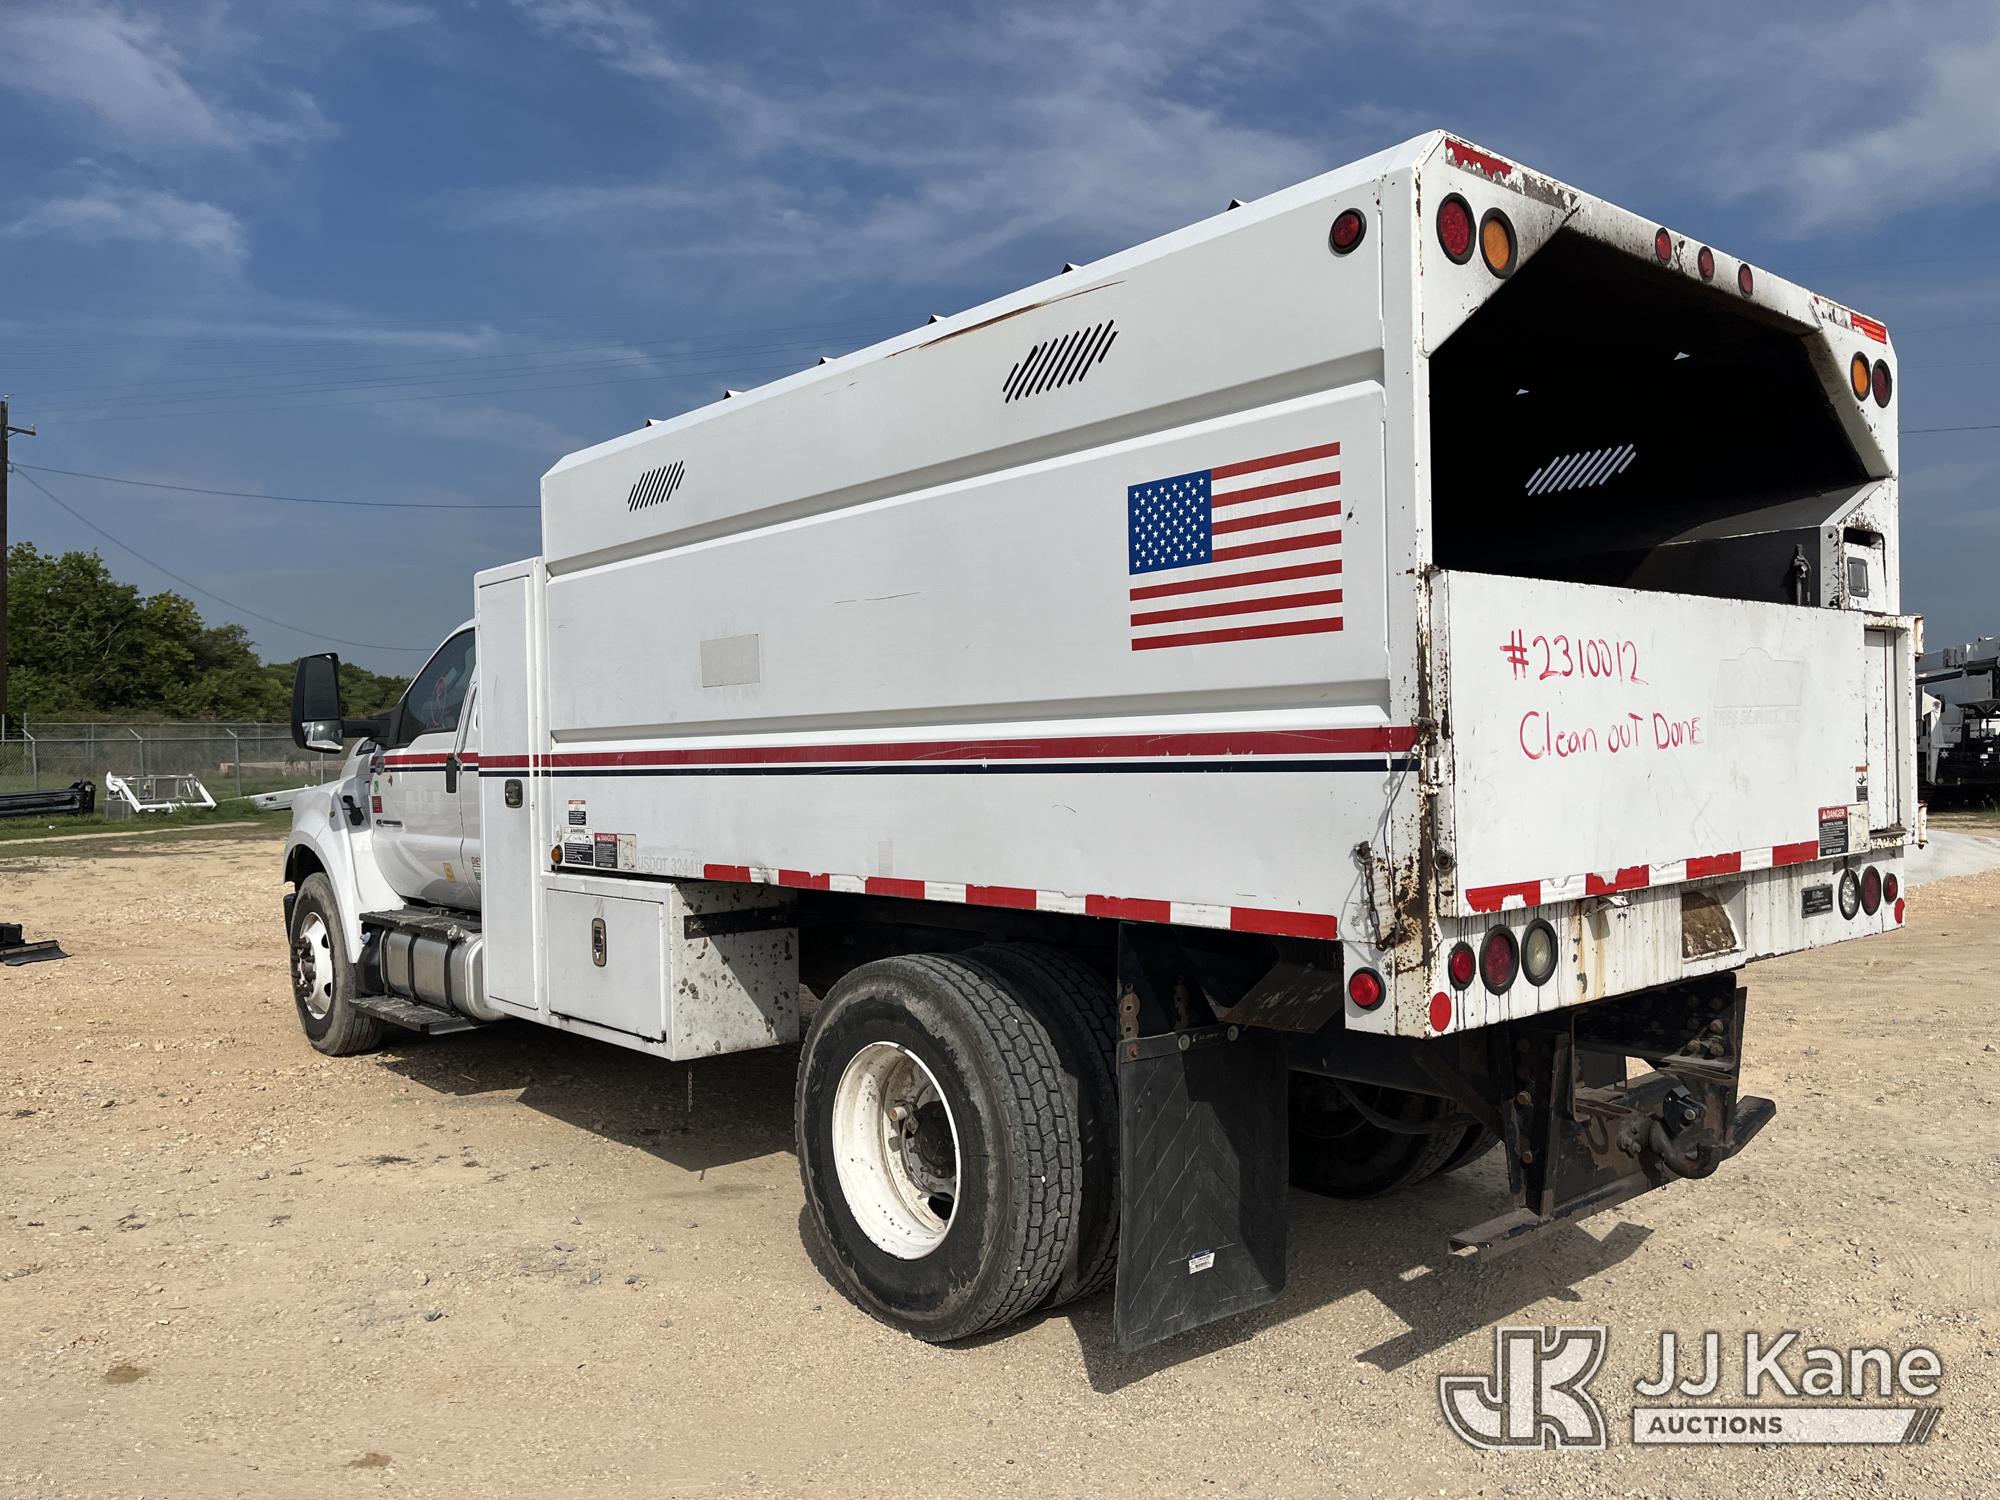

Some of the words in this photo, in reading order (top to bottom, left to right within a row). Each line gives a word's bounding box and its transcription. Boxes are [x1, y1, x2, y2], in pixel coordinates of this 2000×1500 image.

[1499, 628, 1649, 685] #2310012
[1519, 710, 1598, 760] Clean
[1826, 808, 1845, 819] DANGER
